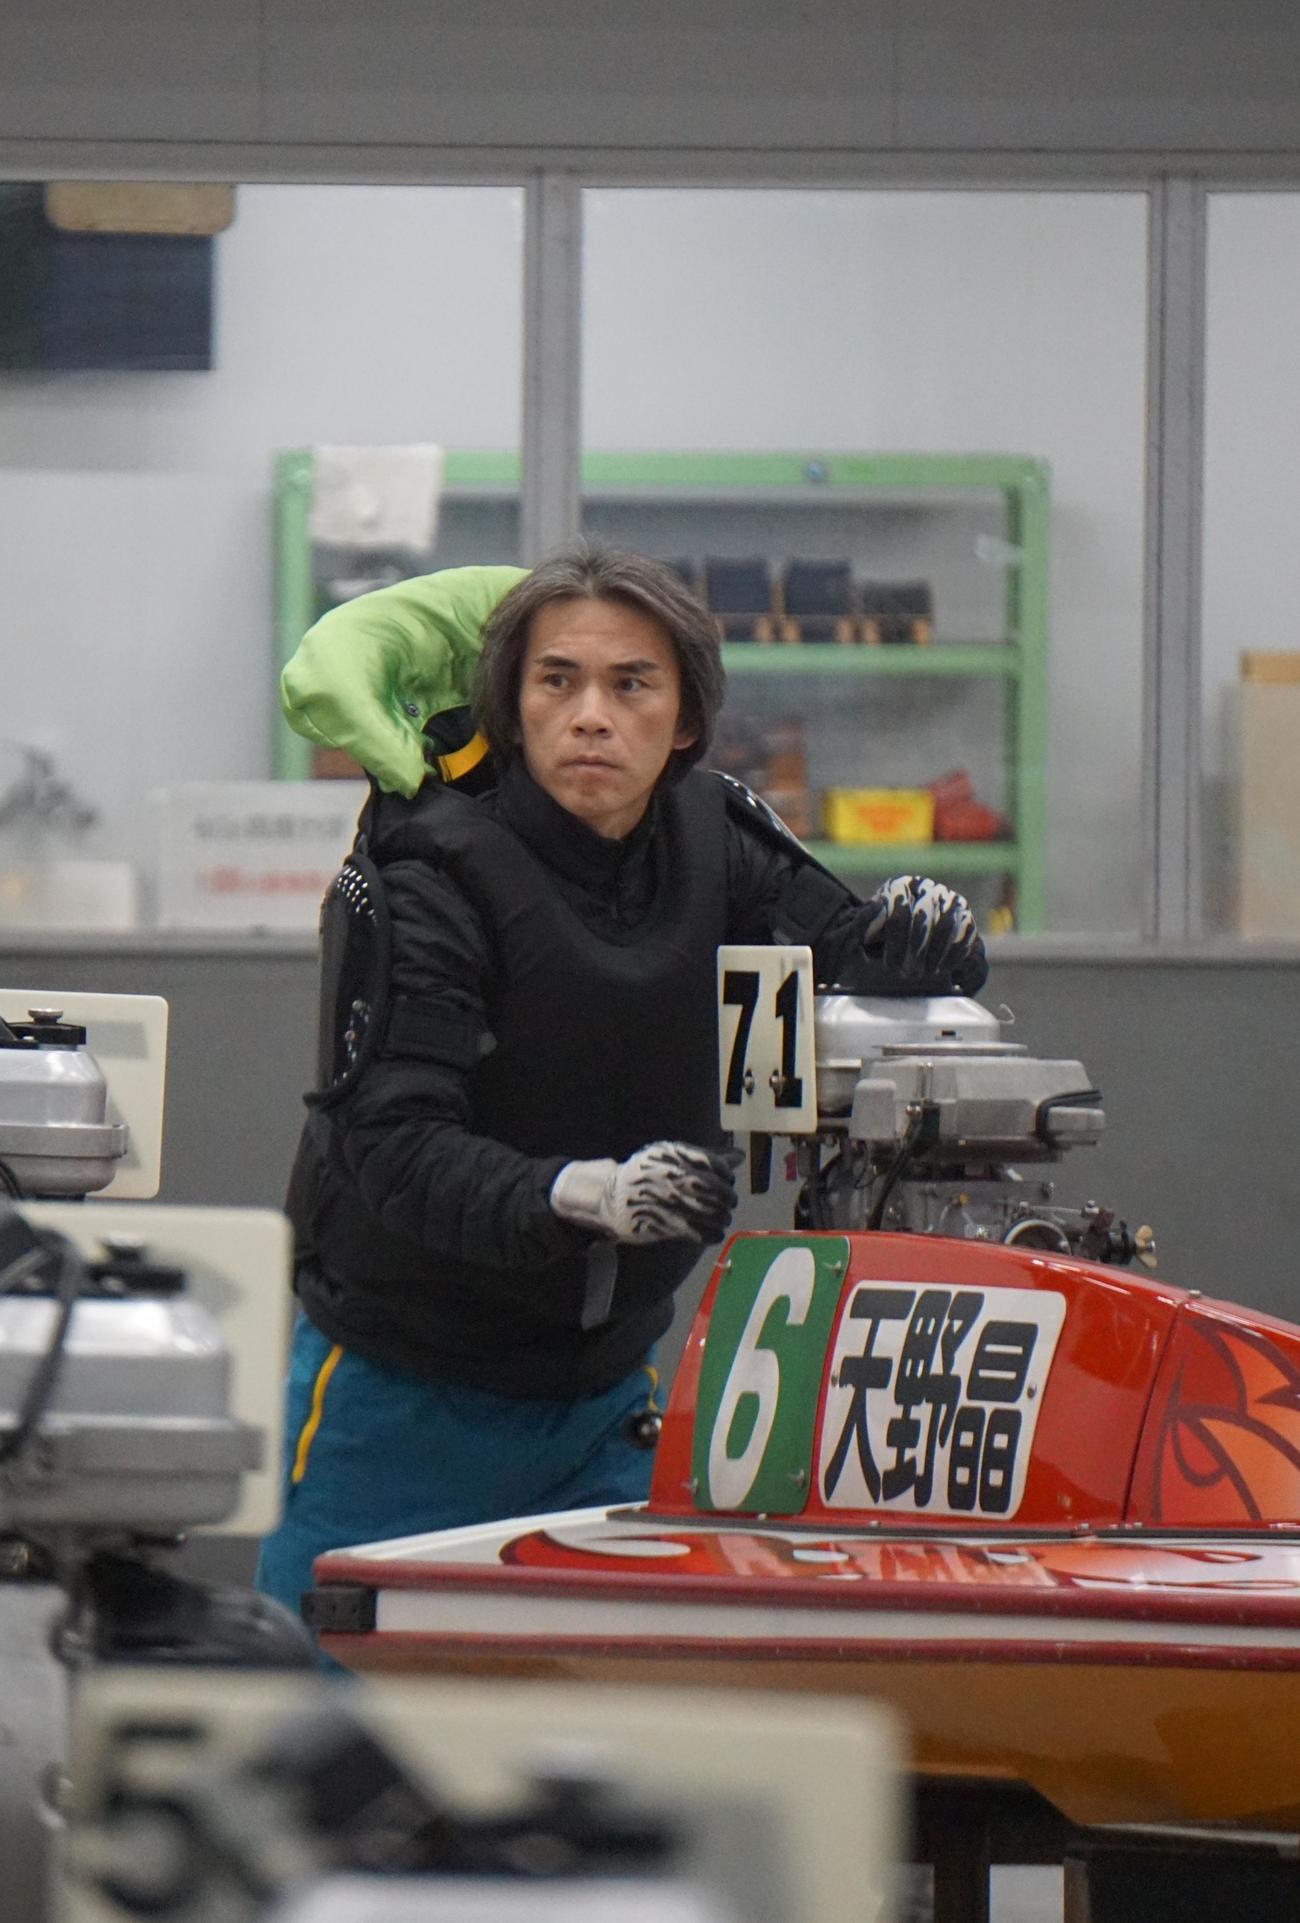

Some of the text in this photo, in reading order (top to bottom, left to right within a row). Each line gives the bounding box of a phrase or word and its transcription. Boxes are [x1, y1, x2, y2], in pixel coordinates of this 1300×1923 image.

[722, 970, 803, 1109] 71
[708, 1247, 815, 1508] 6
[824, 1288, 1038, 1513] 天野晶
